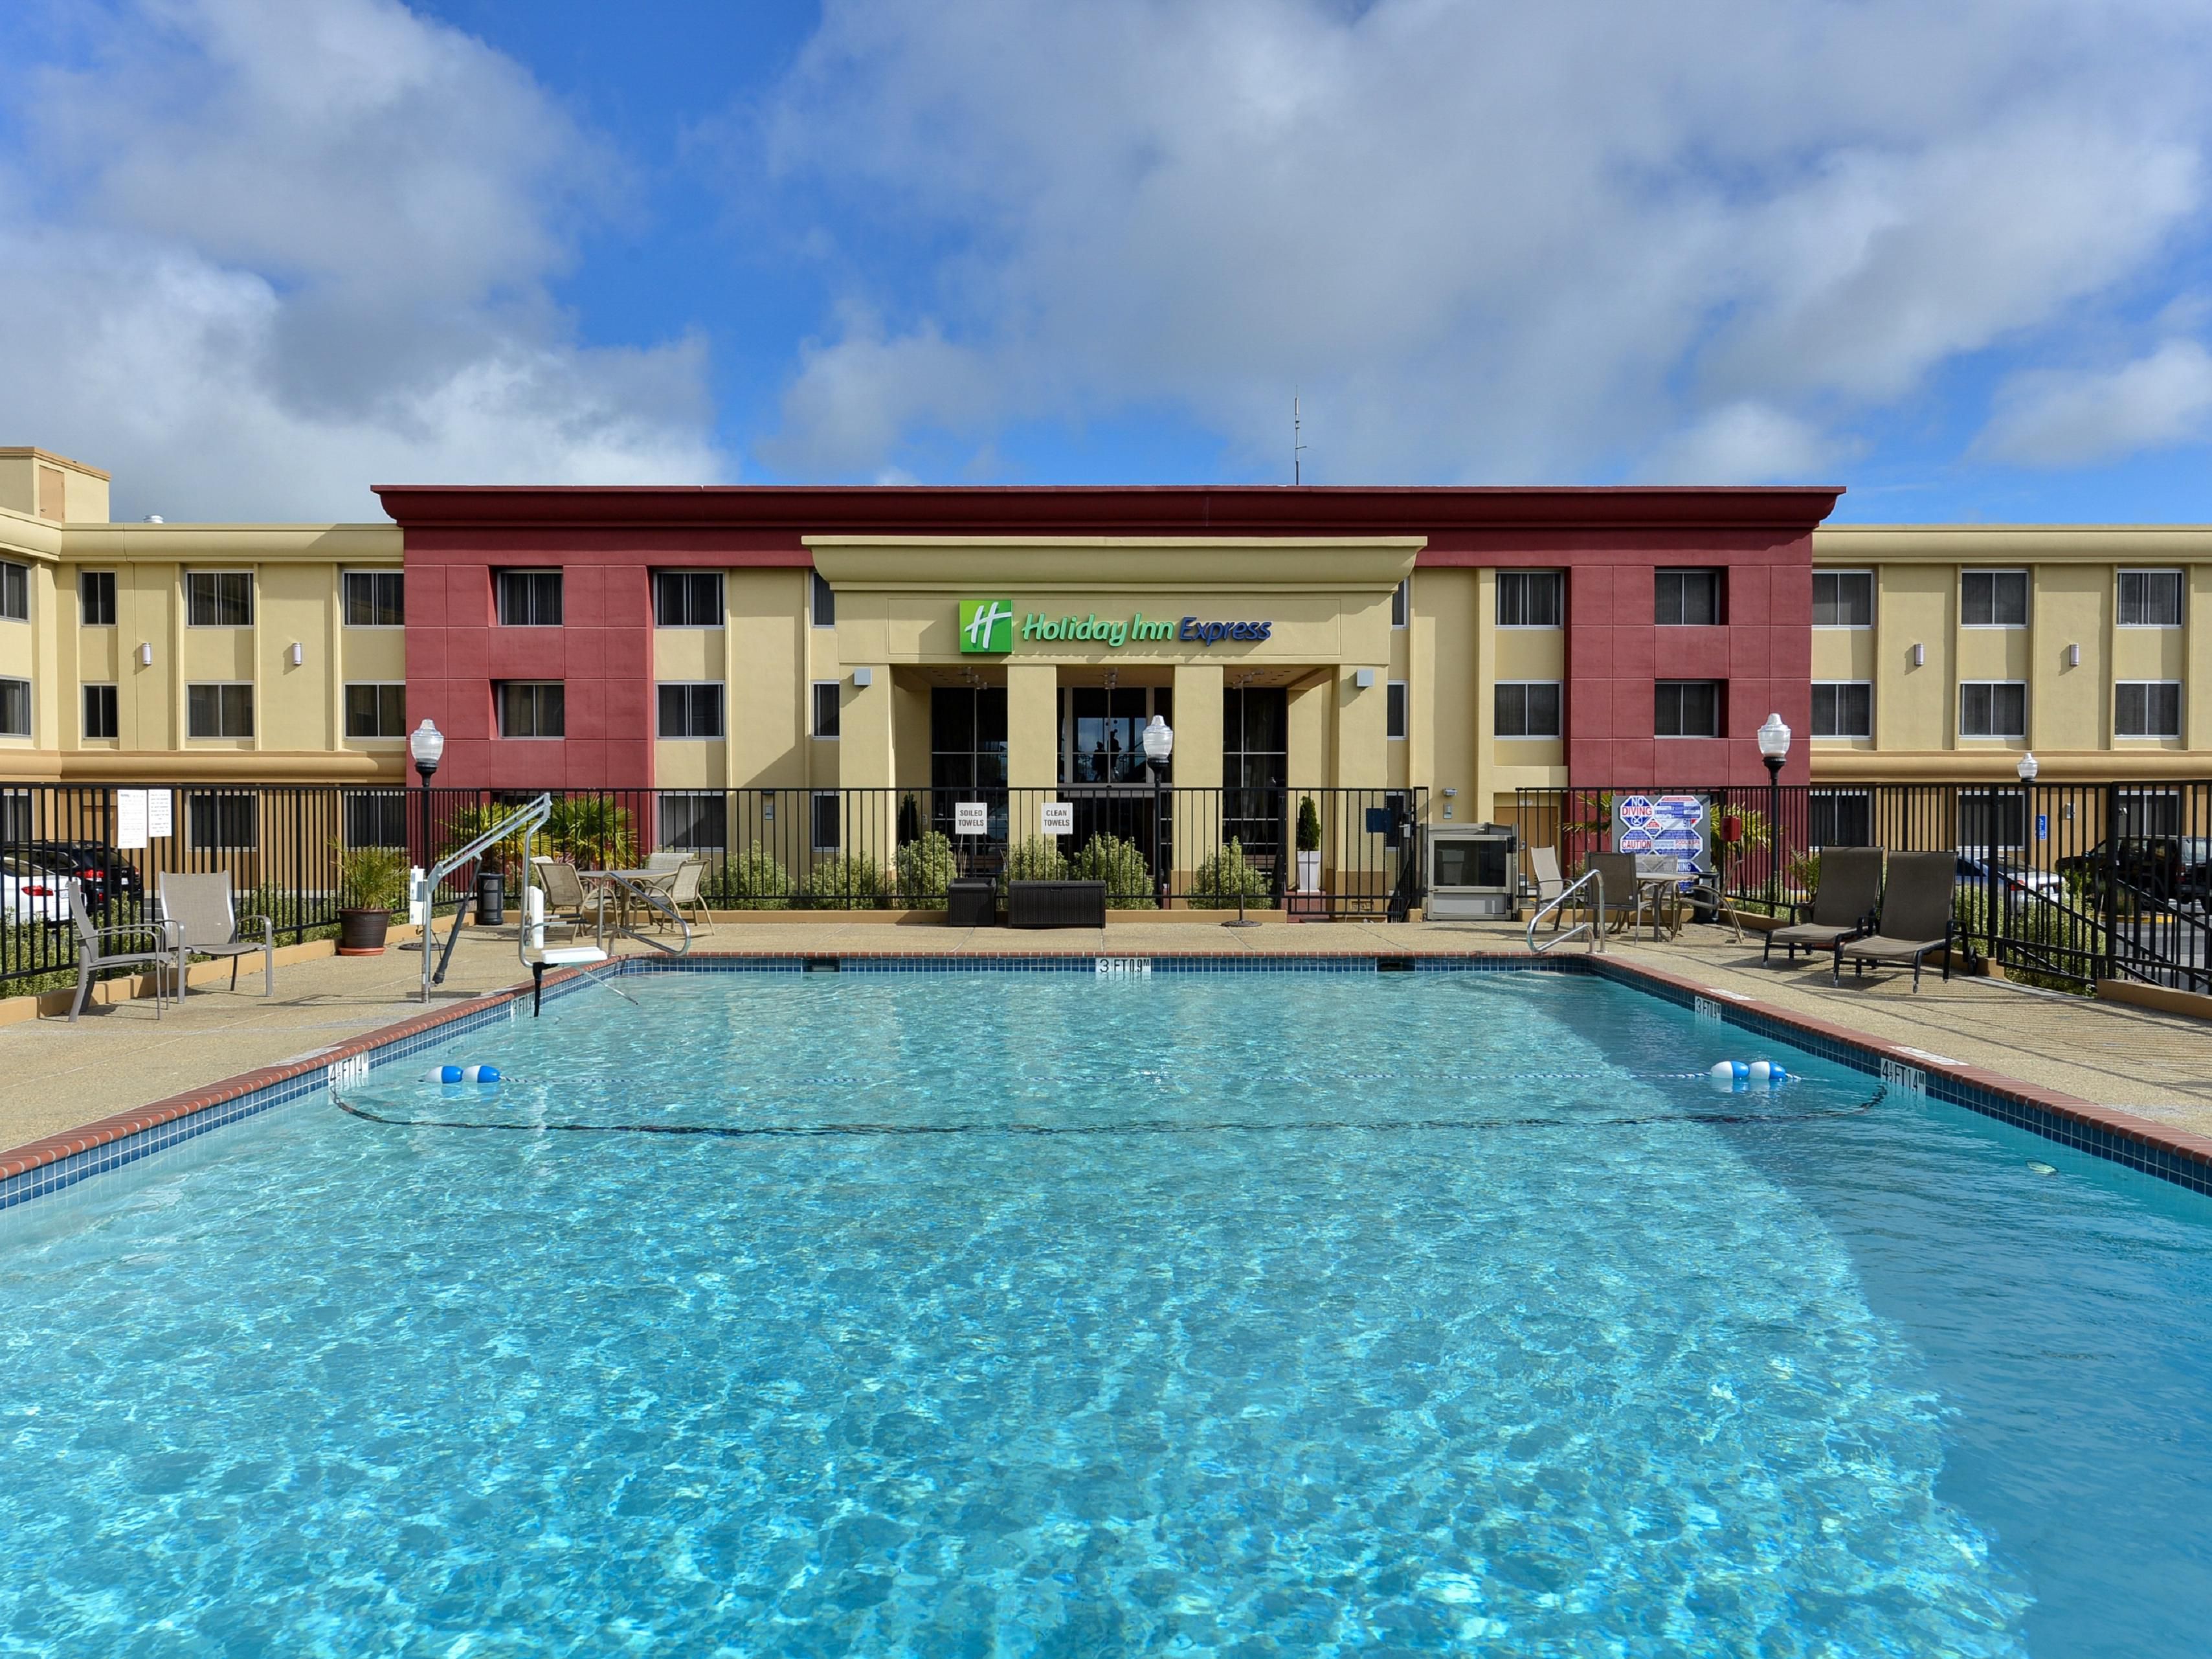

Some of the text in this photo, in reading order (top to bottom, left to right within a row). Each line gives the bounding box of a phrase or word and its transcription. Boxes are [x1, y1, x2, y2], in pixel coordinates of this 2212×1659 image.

[1022, 612, 1273, 647] Holiday Inn Express
[1631, 797, 1644, 807] NO
[1622, 807, 1653, 816] DIVING
[1622, 840, 1651, 849] CAUTION
[1099, 959, 1110, 973] 3
[1114, 959, 1128, 972] FT
[342, 1058, 352, 1079] FT
[1895, 1064, 1906, 1086] FT
